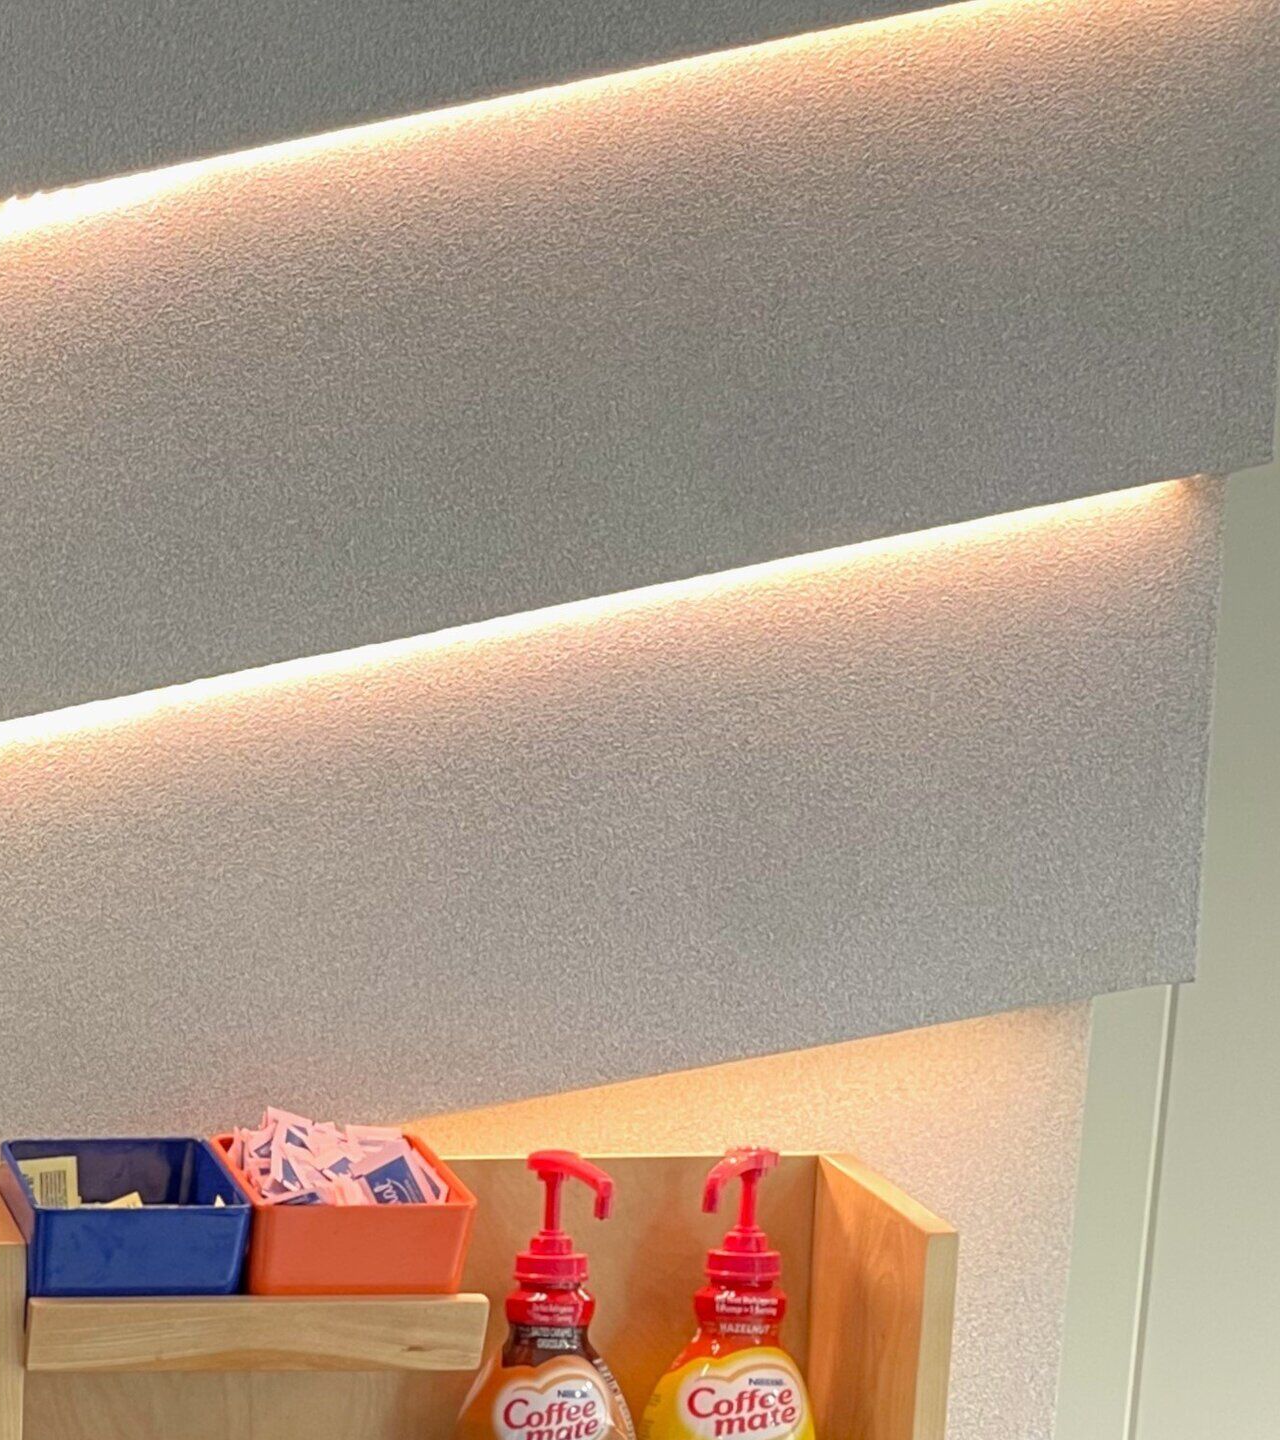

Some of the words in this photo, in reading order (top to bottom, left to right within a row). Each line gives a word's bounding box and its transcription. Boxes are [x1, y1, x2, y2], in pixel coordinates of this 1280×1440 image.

[720, 1323, 770, 1334] HAZELNUT
[503, 1398, 596, 1429] Coffee
[687, 1387, 792, 1418] Coffee
[714, 1406, 796, 1436] mate
